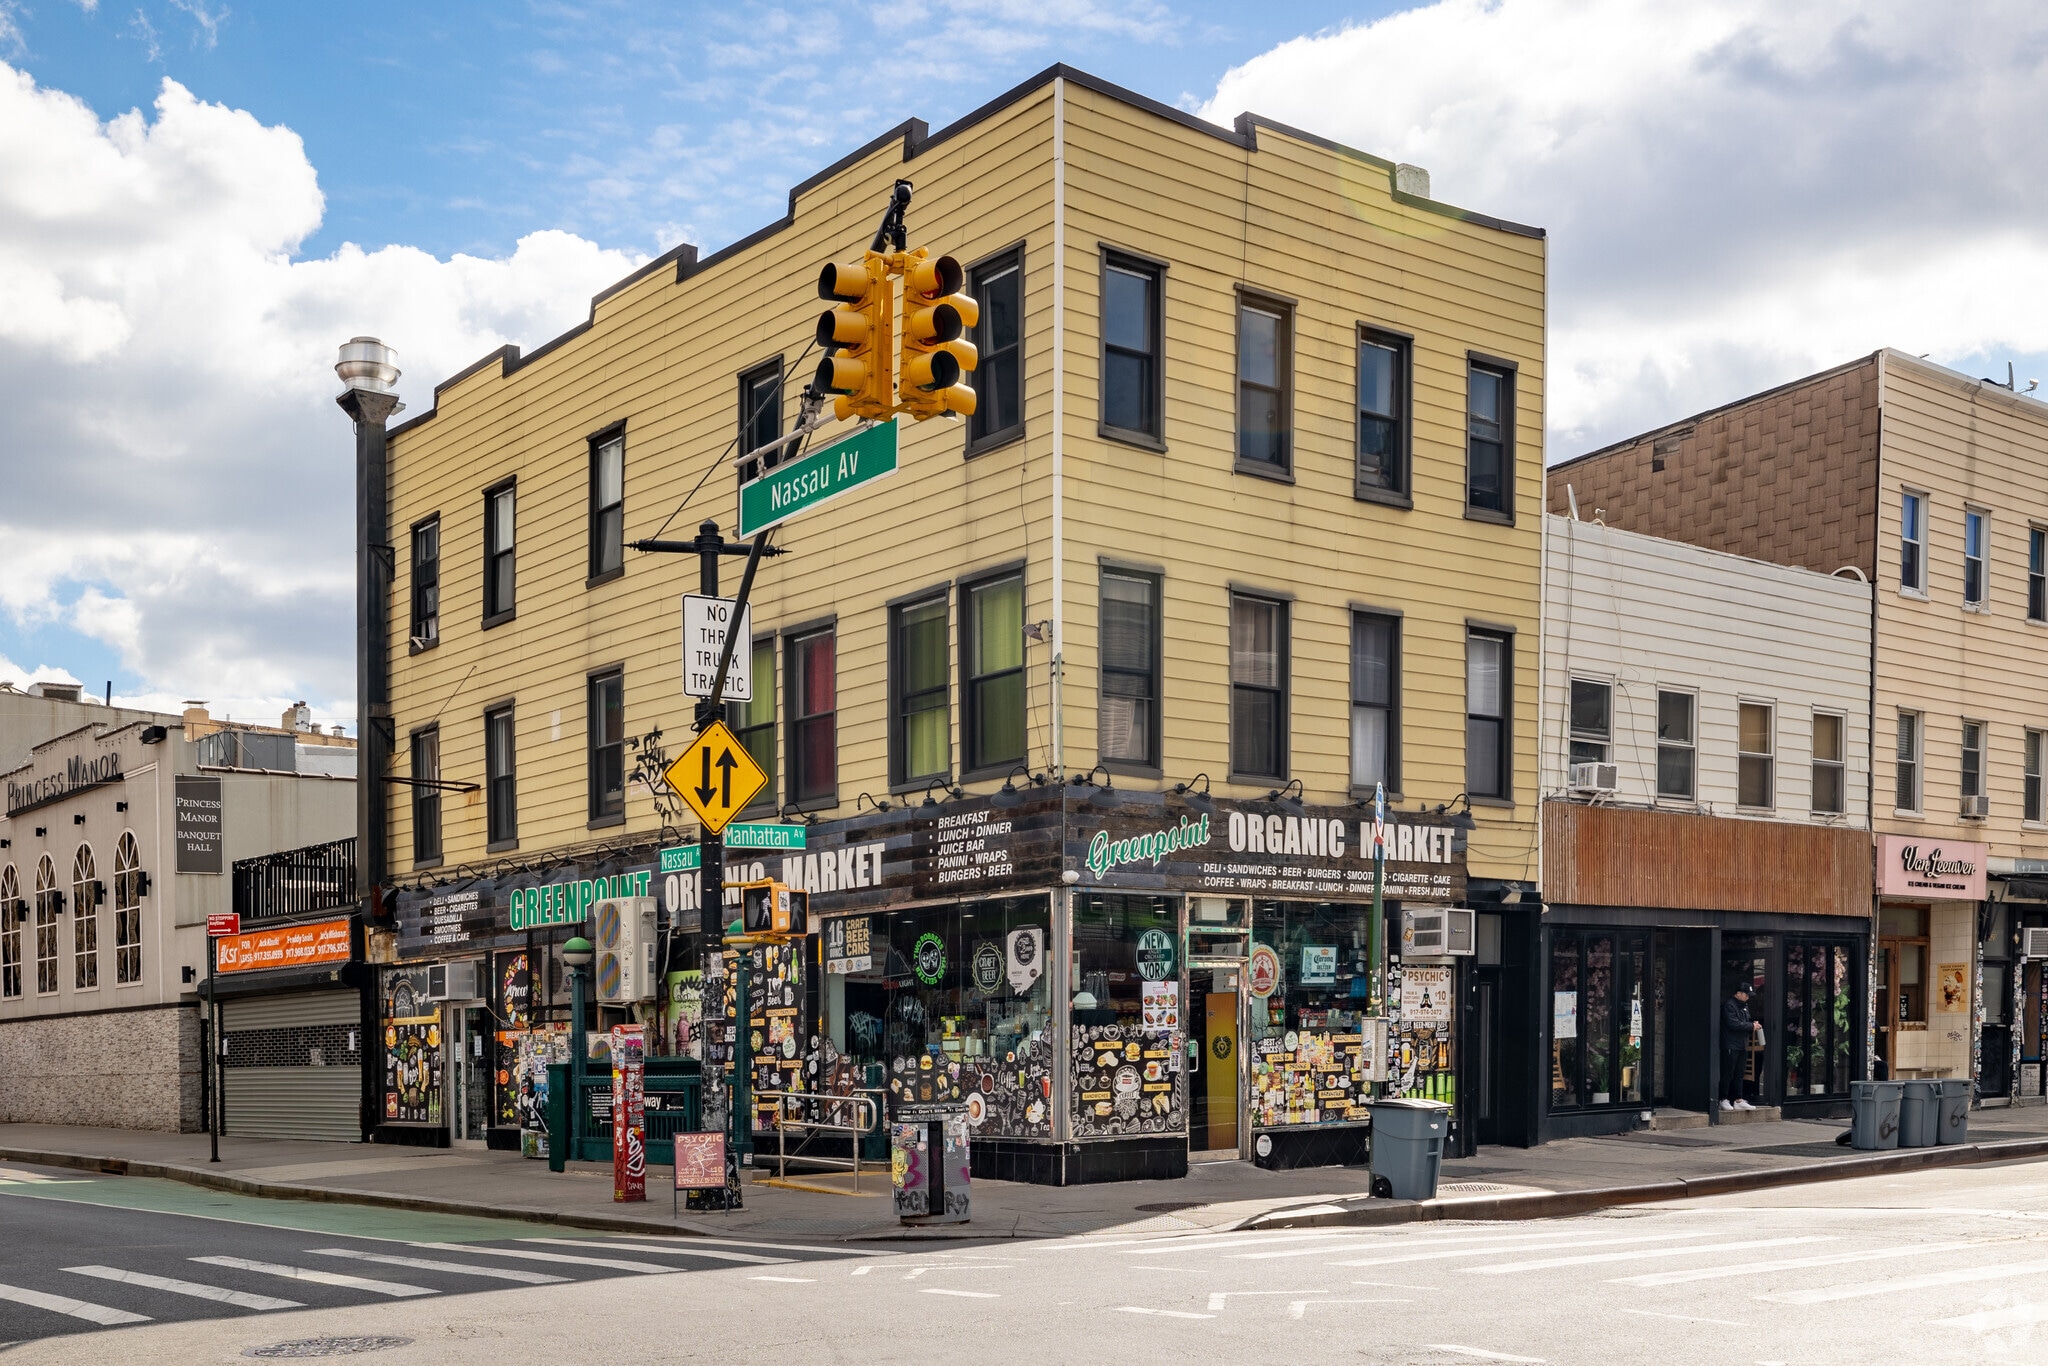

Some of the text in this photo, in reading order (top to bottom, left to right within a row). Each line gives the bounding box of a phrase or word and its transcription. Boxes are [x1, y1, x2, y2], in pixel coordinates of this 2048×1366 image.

[771, 450, 859, 511] Nassau Av
[707, 606, 727, 622] NO
[700, 628, 726, 645] THR
[696, 651, 739, 669] TRUK
[692, 673, 744, 693] TRAFIC
[176, 797, 221, 809] PRINCESS
[180, 812, 218, 823] MANOR
[938, 810, 989, 829] BREAKFAST
[177, 831, 222, 841] BANQUET
[724, 827, 804, 847] Manhattan Av
[938, 821, 1012, 843] LUNCH DINNER
[1228, 811, 1455, 864] ORGANIC MARKET
[187, 843, 213, 852] HALL
[938, 839, 985, 856] JUICE BAR
[1085, 812, 1211, 881] Greenpoint
[661, 851, 693, 871] Nassau
[938, 850, 1008, 869] PANINI WRAPS
[1903, 845, 1976, 878] Van Leeuwen
[782, 842, 886, 897] MARKET
[938, 863, 1013, 884] BURGERS BEER
[1204, 863, 1221, 873] DELI
[1227, 864, 1277, 876] SANDWICHES
[1282, 865, 1302, 877] BEER
[1307, 867, 1341, 880] BURGERS
[1392, 874, 1429, 884] CIGARETTE
[1433, 875, 1451, 885] CAKE
[1204, 877, 1234, 888] COFFEE
[1240, 878, 1267, 889] WRAPS
[1272, 880, 1313, 891] BREAKFAST
[1318, 881, 1343, 892] LUNCH
[1382, 885, 1404, 895] PANINI
[1409, 886, 1430, 896] FRESH
[1431, 886, 1450, 897] JUICE
[433, 891, 479, 906] DELI SANDWICHES
[434, 901, 478, 916] BEER CIGARETTES
[434, 914, 463, 925] QUESADILLA
[846, 917, 870, 930] CRAFT
[434, 924, 461, 935] SMOOTHIES
[828, 920, 844, 947] 16
[846, 928, 870, 943] BEER
[241, 940, 251, 950] FOR
[434, 935, 453, 944] COFFEE
[457, 932, 470, 941] CAKE
[1145, 933, 1164, 949] NEW
[846, 941, 870, 956] CANS
[979, 957, 996, 967] CRAFT
[982, 970, 996, 980] BEER
[1144, 962, 1166, 979] YORK
[1408, 971, 1444, 982] PSYCHIC
[1633, 1003, 1640, 1015] A
[554, 1022, 566, 1031] ICE
[1263, 1038, 1275, 1046] BEST
[1040, 1122, 1050, 1131] Tea
[678, 1134, 723, 1144] PSYCHIC
